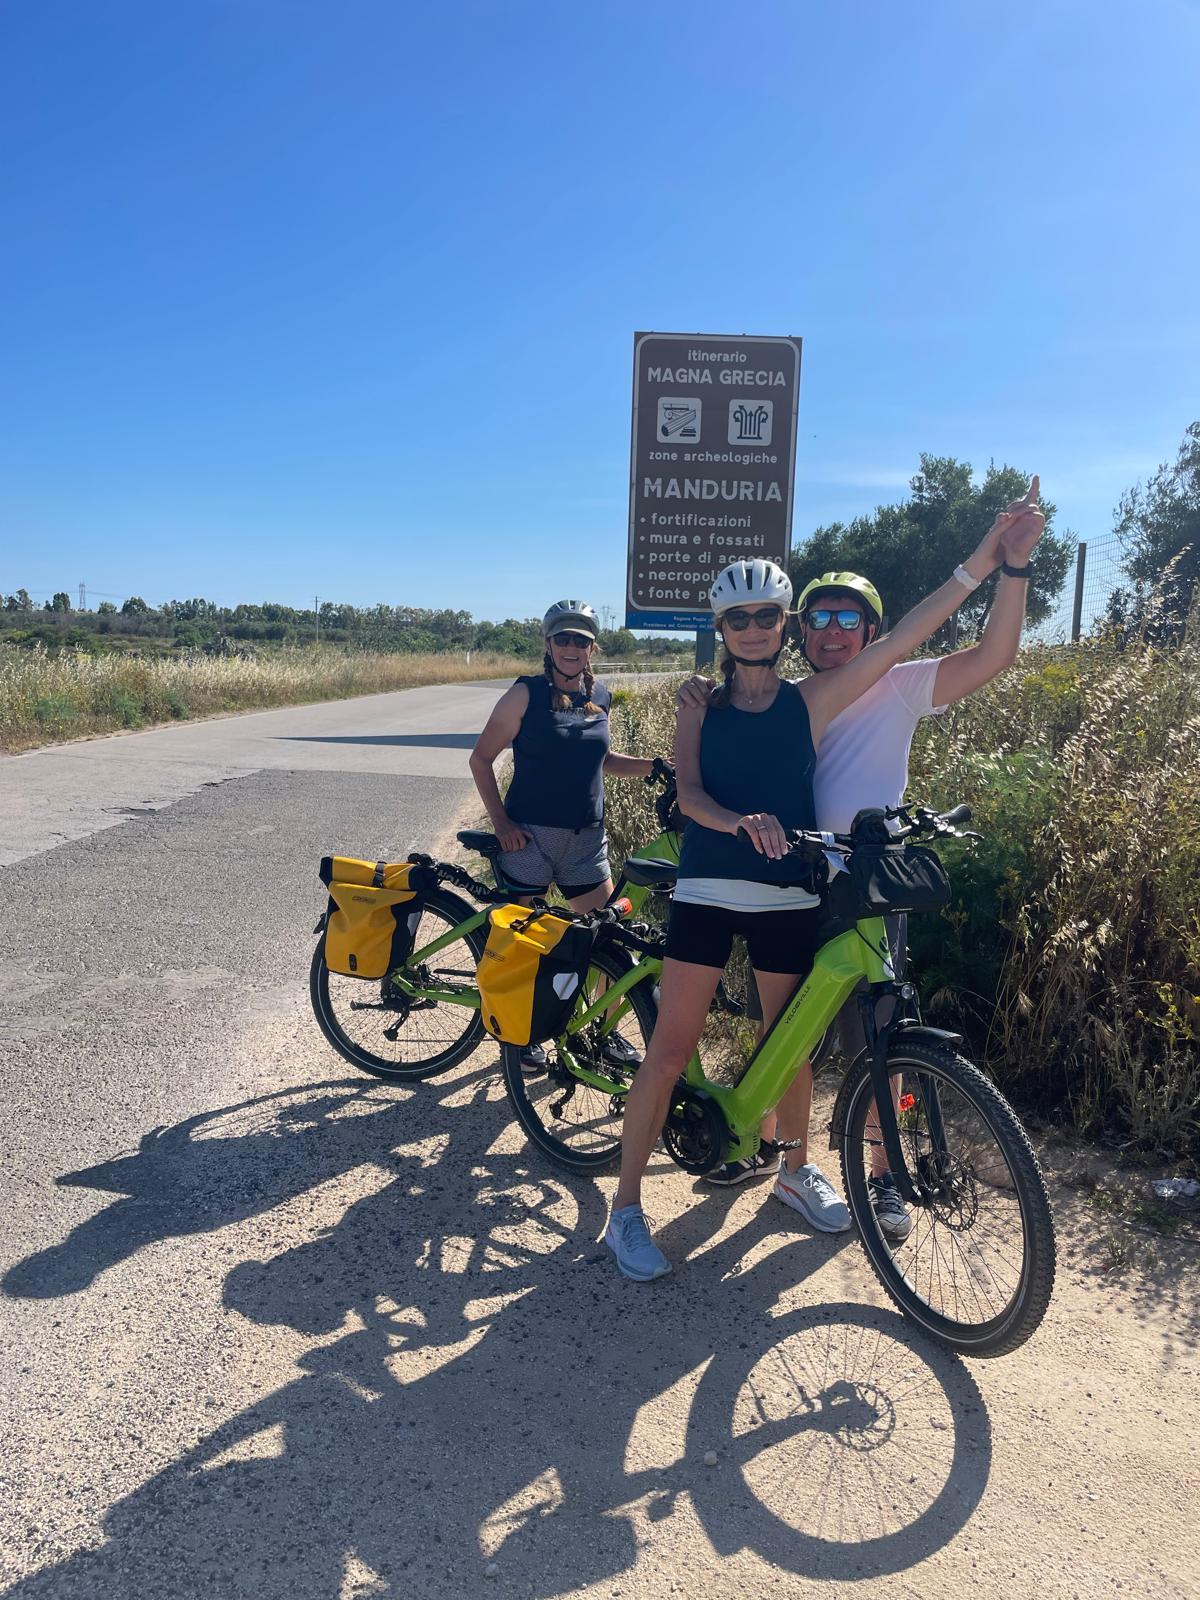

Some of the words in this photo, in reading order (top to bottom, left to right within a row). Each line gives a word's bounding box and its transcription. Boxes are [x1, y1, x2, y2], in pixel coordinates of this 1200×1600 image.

[688, 349, 747, 363] itinerario
[647, 367, 713, 385] MAGNA
[719, 370, 786, 387] GRECIA
[649, 451, 678, 461] zone
[684, 452, 778, 465] archeologiche
[643, 477, 783, 502] MANDURIA
[651, 513, 751, 528] fortificazioni
[649, 533, 688, 545] mura
[693, 535, 702, 545] e
[709, 533, 765, 547] fossati
[649, 552, 691, 564] porte
[698, 551, 711, 564] di
[648, 586, 690, 600] fonte
